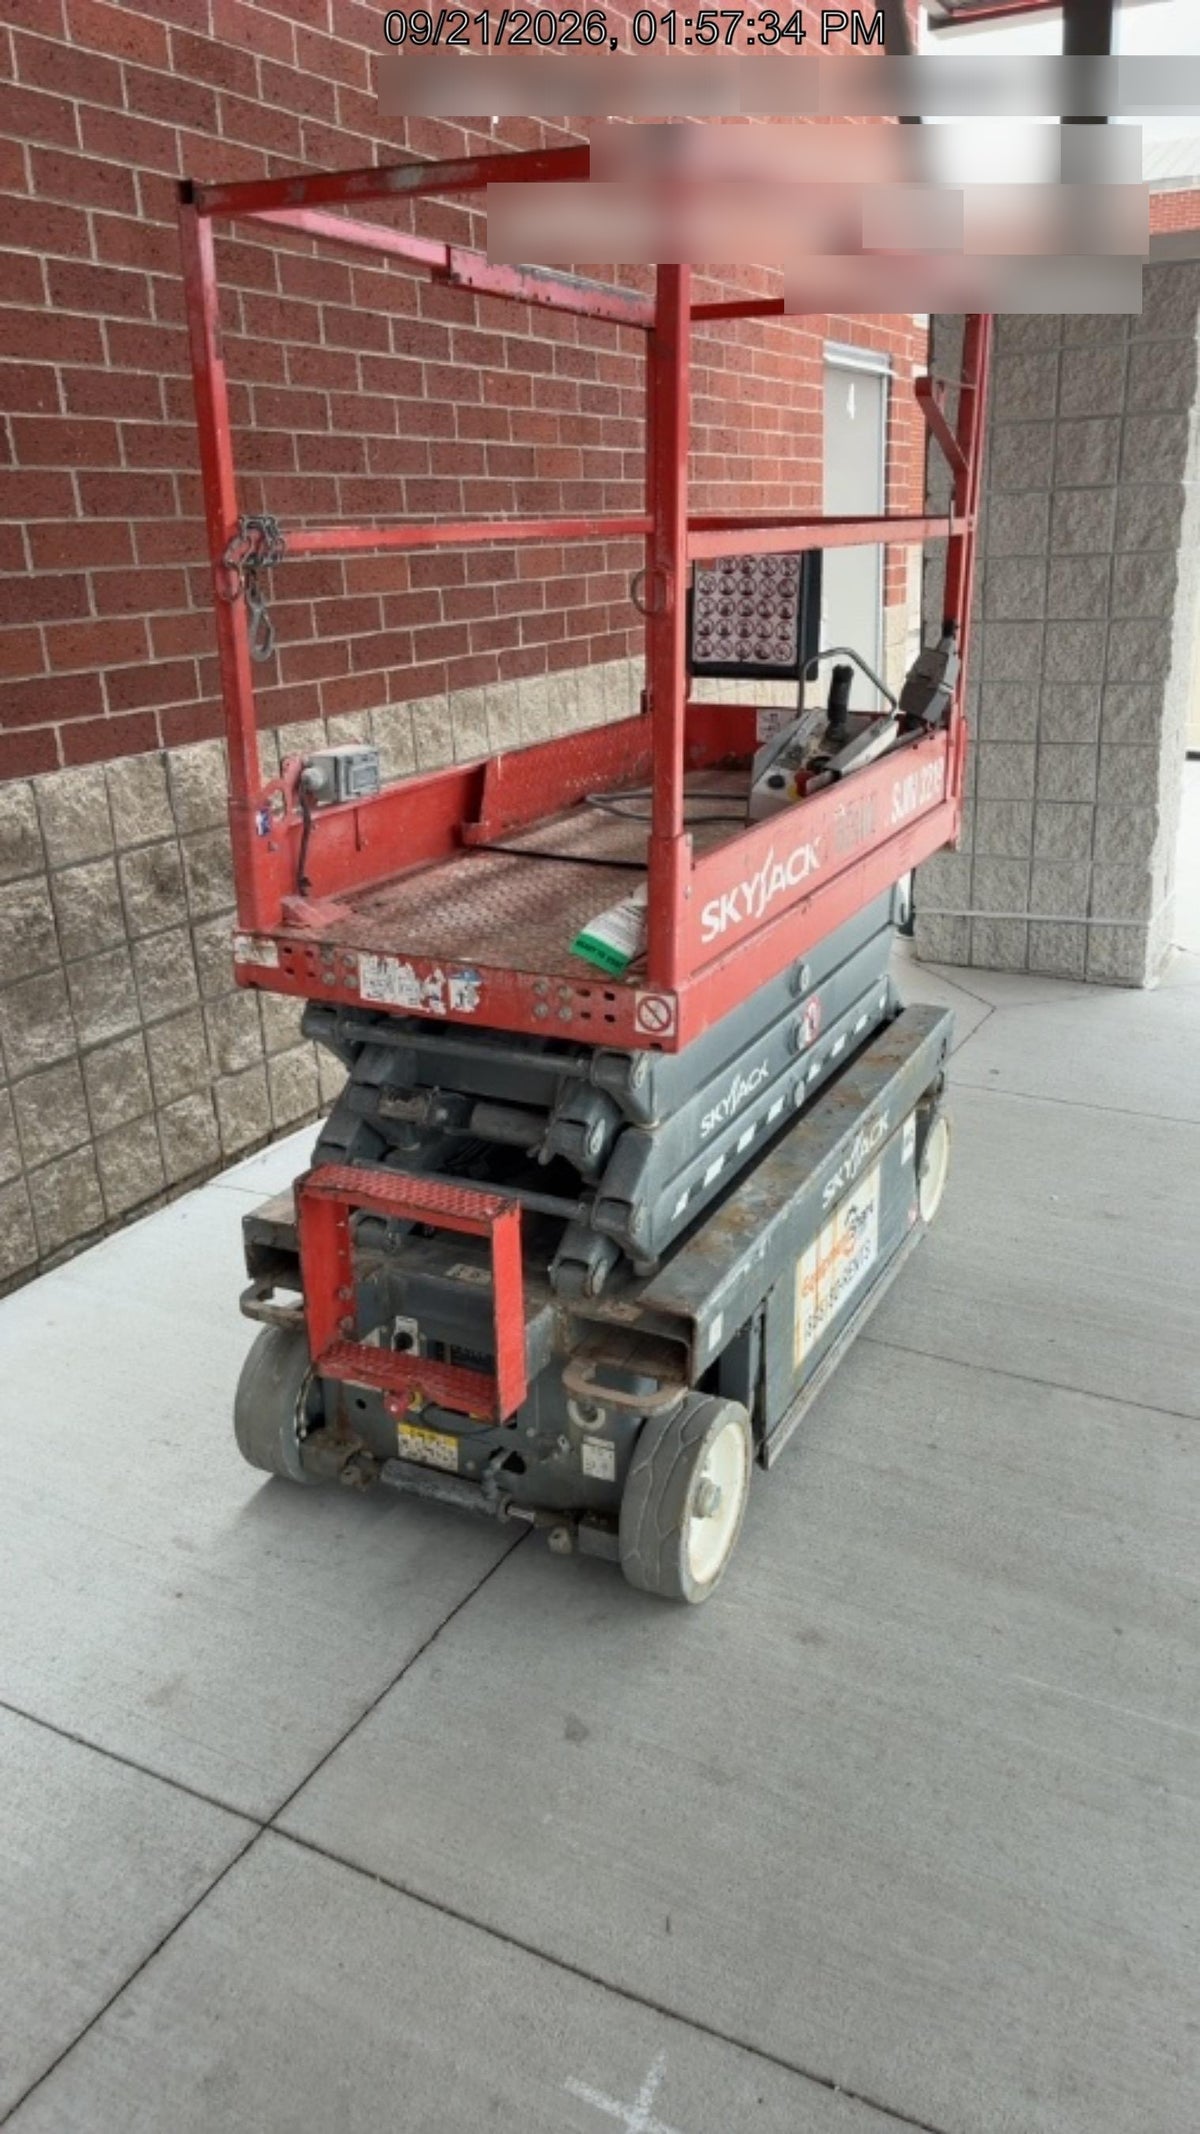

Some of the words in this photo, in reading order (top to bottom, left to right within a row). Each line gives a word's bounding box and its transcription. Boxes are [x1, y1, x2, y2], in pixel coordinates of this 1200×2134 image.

[701, 836, 822, 943] SKYJACK
[701, 1059, 769, 1139] SKYJACK
[822, 1108, 890, 1210] SKYJACK
